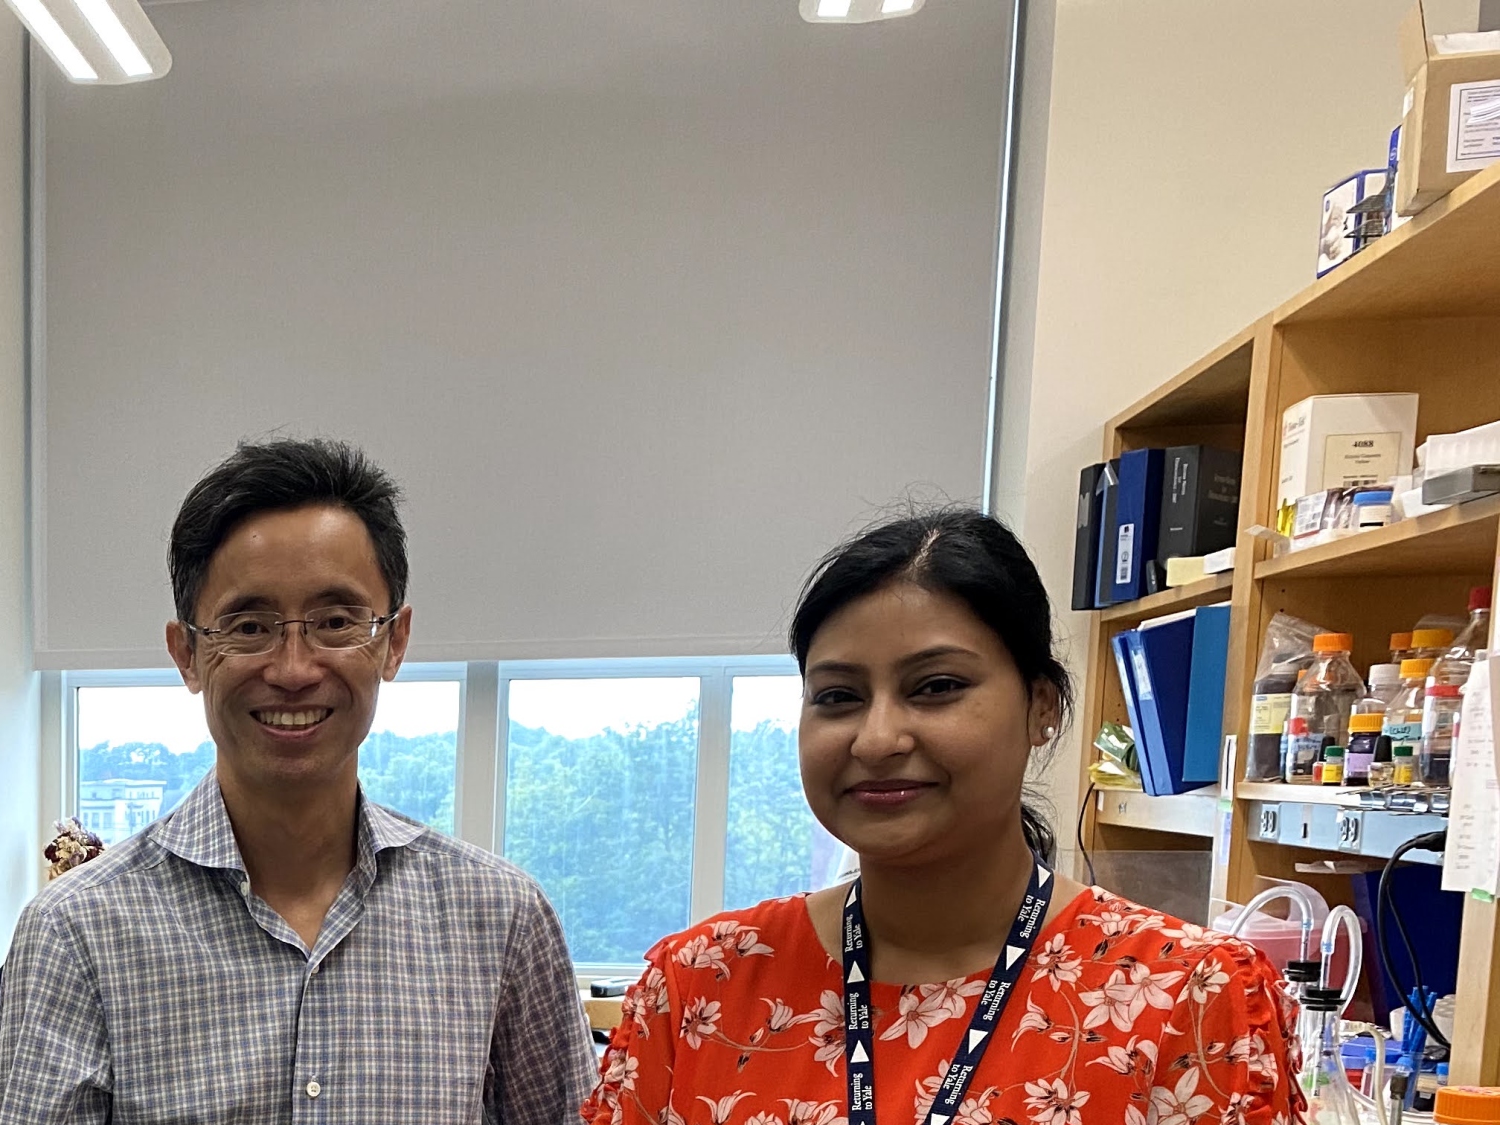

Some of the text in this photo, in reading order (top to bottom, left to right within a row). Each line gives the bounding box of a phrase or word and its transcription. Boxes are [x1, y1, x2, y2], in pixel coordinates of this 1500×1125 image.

[1018, 894, 1034, 922] to Yale
[1020, 898, 1046, 939] Returning
[845, 914, 854, 952] Returning
[856, 938, 863, 949] to
[981, 979, 998, 1006] to Yale
[982, 981, 1012, 1021] Returning
[847, 992, 859, 1030] Returning
[859, 1004, 868, 1029] to Yale
[850, 1072, 863, 1111] Returning
[942, 1064, 960, 1089] to Yale
[944, 1065, 974, 1105] Returning
[862, 1085, 872, 1110] to Yale
